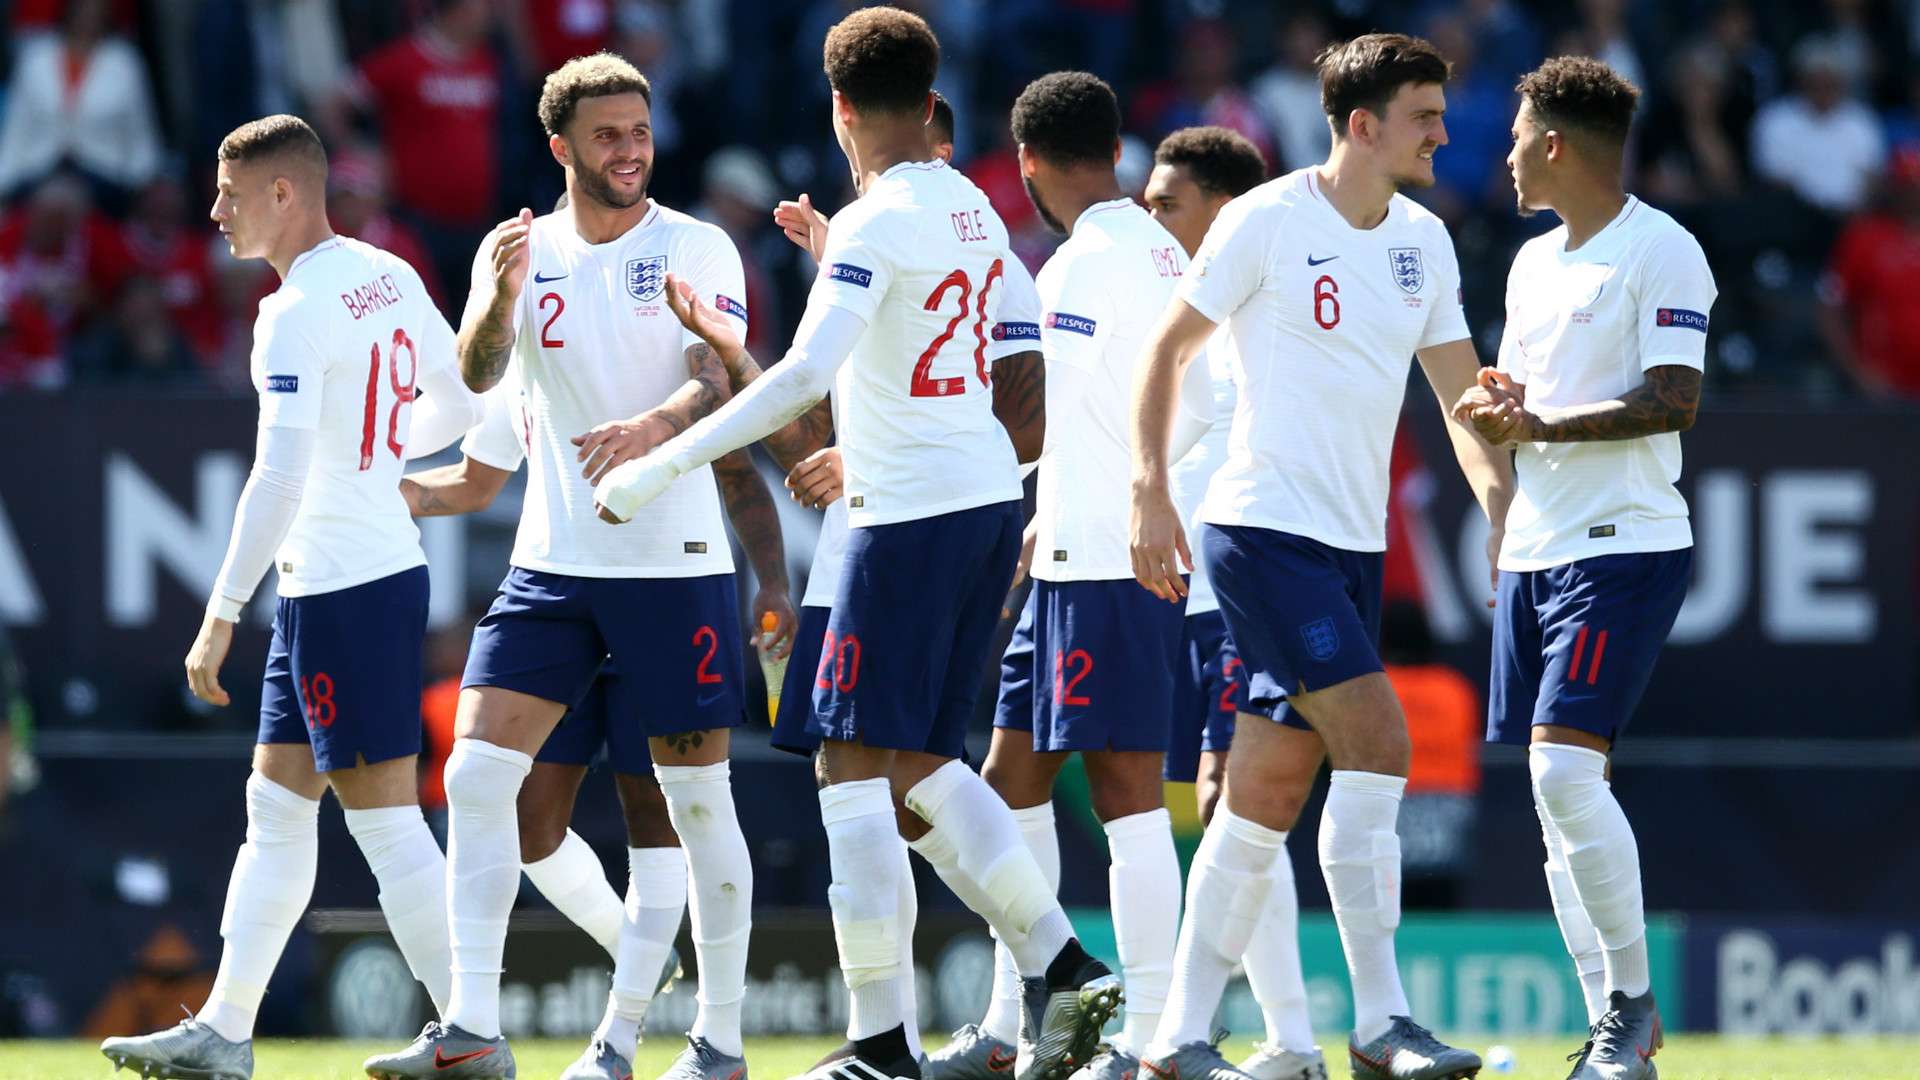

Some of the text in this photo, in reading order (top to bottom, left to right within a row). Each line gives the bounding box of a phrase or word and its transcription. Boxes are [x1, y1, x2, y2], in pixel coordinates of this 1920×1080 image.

[951, 209, 988, 242] DELE
[833, 266, 871, 285] RESPECT
[1314, 274, 1340, 331] 6
[538, 292, 565, 348] 2
[1057, 316, 1096, 333] RESPECT
[1673, 313, 1707, 330] RESPECT
[358, 328, 416, 471] 18
[691, 624, 724, 685] 2
[816, 629, 862, 694] 20
[1056, 648, 1093, 707] 12
[1567, 626, 1608, 685] 11
[300, 671, 337, 731] 18
